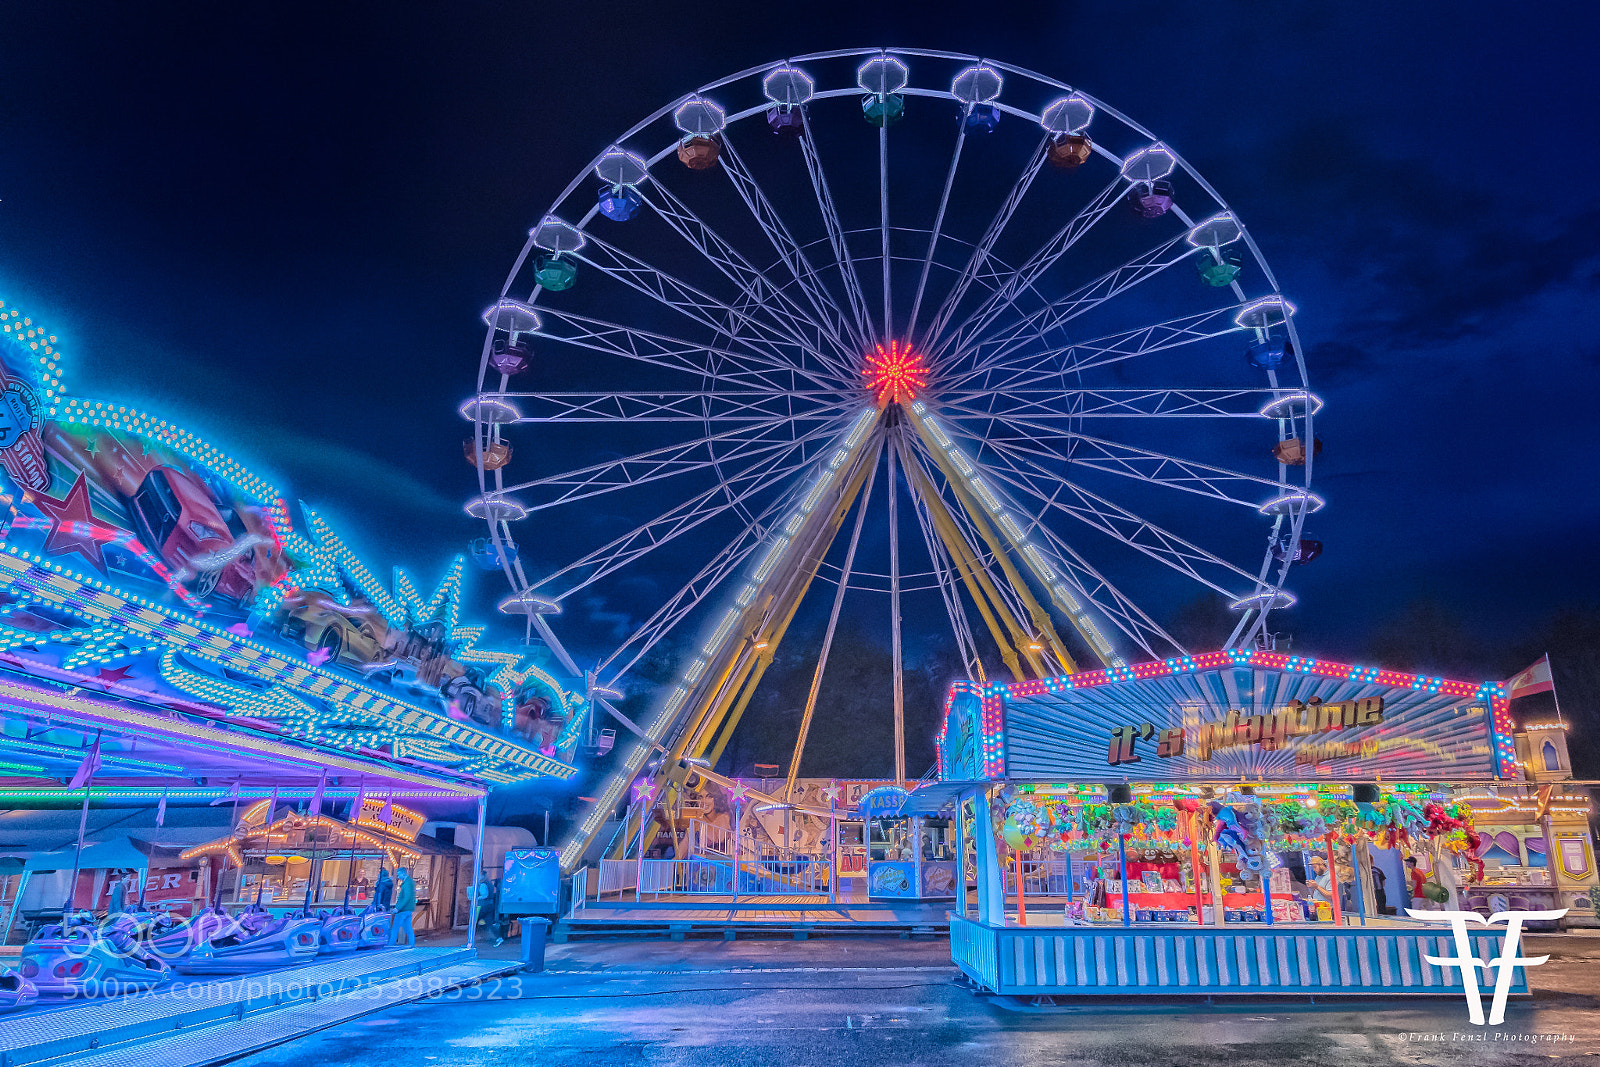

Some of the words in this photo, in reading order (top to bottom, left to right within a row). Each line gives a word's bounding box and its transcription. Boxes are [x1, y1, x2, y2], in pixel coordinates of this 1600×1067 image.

[14, 440, 46, 491] STATION
[1107, 722, 1185, 767] it's
[1199, 694, 1385, 762] playtime
